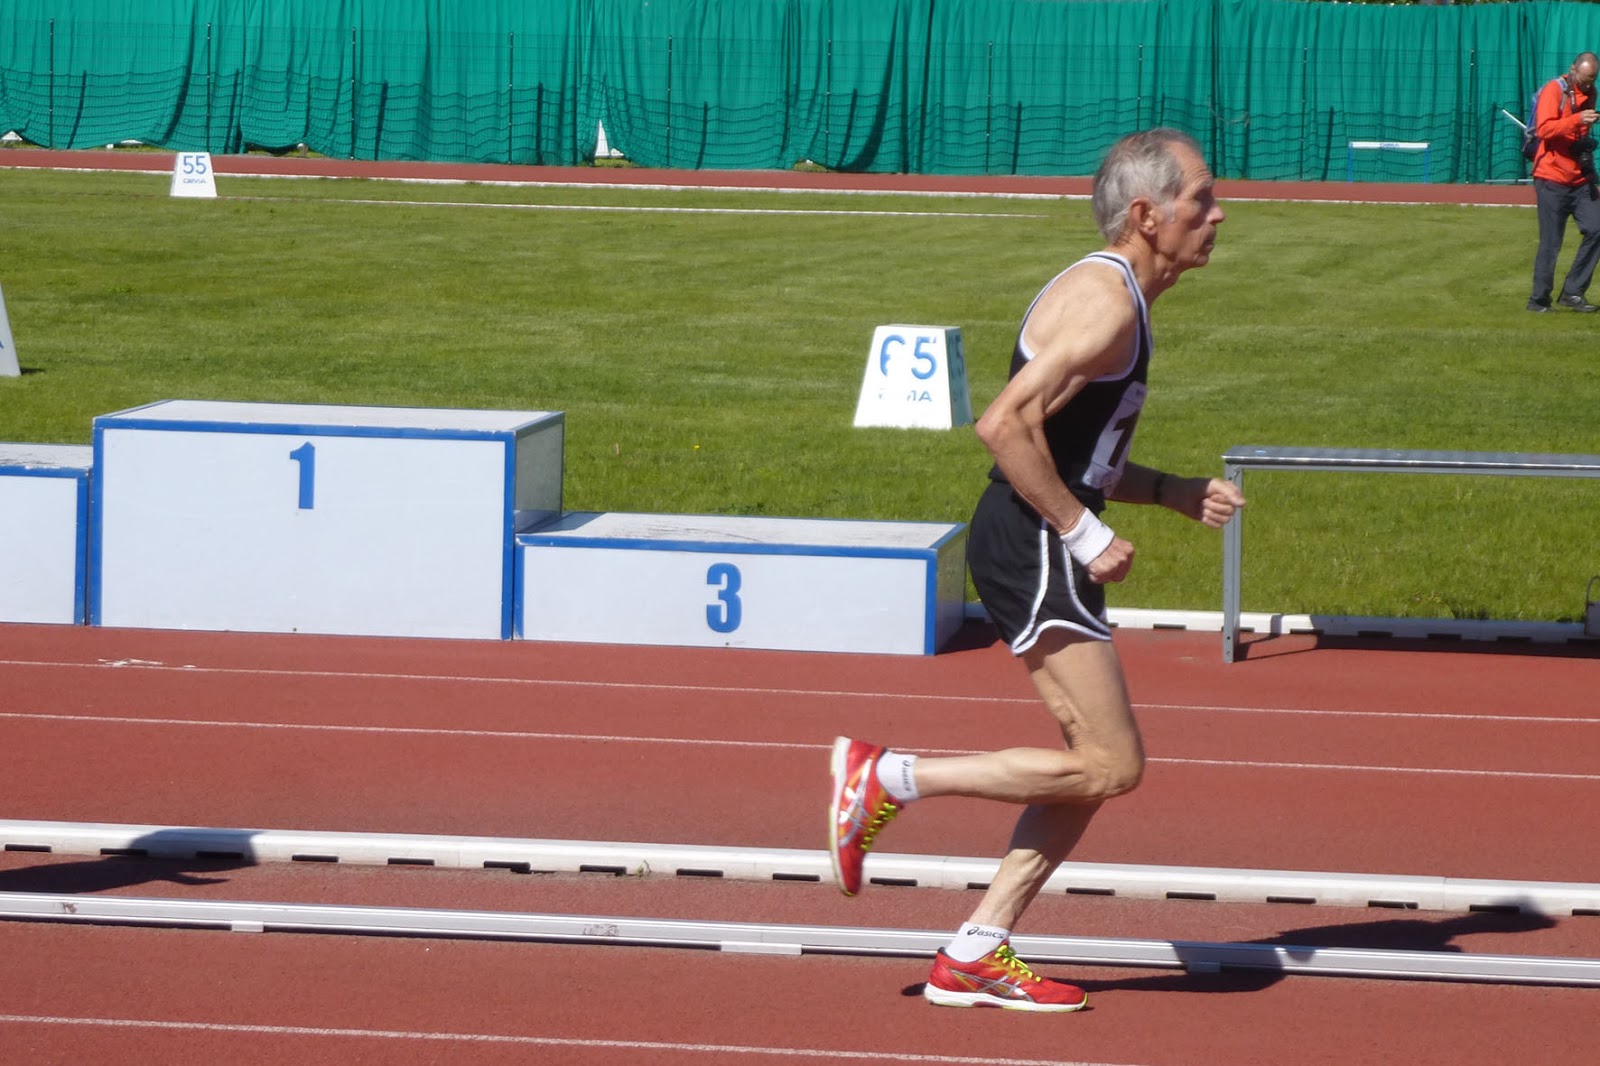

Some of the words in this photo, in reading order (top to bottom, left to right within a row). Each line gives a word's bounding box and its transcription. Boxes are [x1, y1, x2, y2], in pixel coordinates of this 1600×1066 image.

[183, 155, 207, 175] 55
[289, 441, 315, 509] 1
[706, 562, 742, 633] 3
[976, 929, 1005, 939] asics
